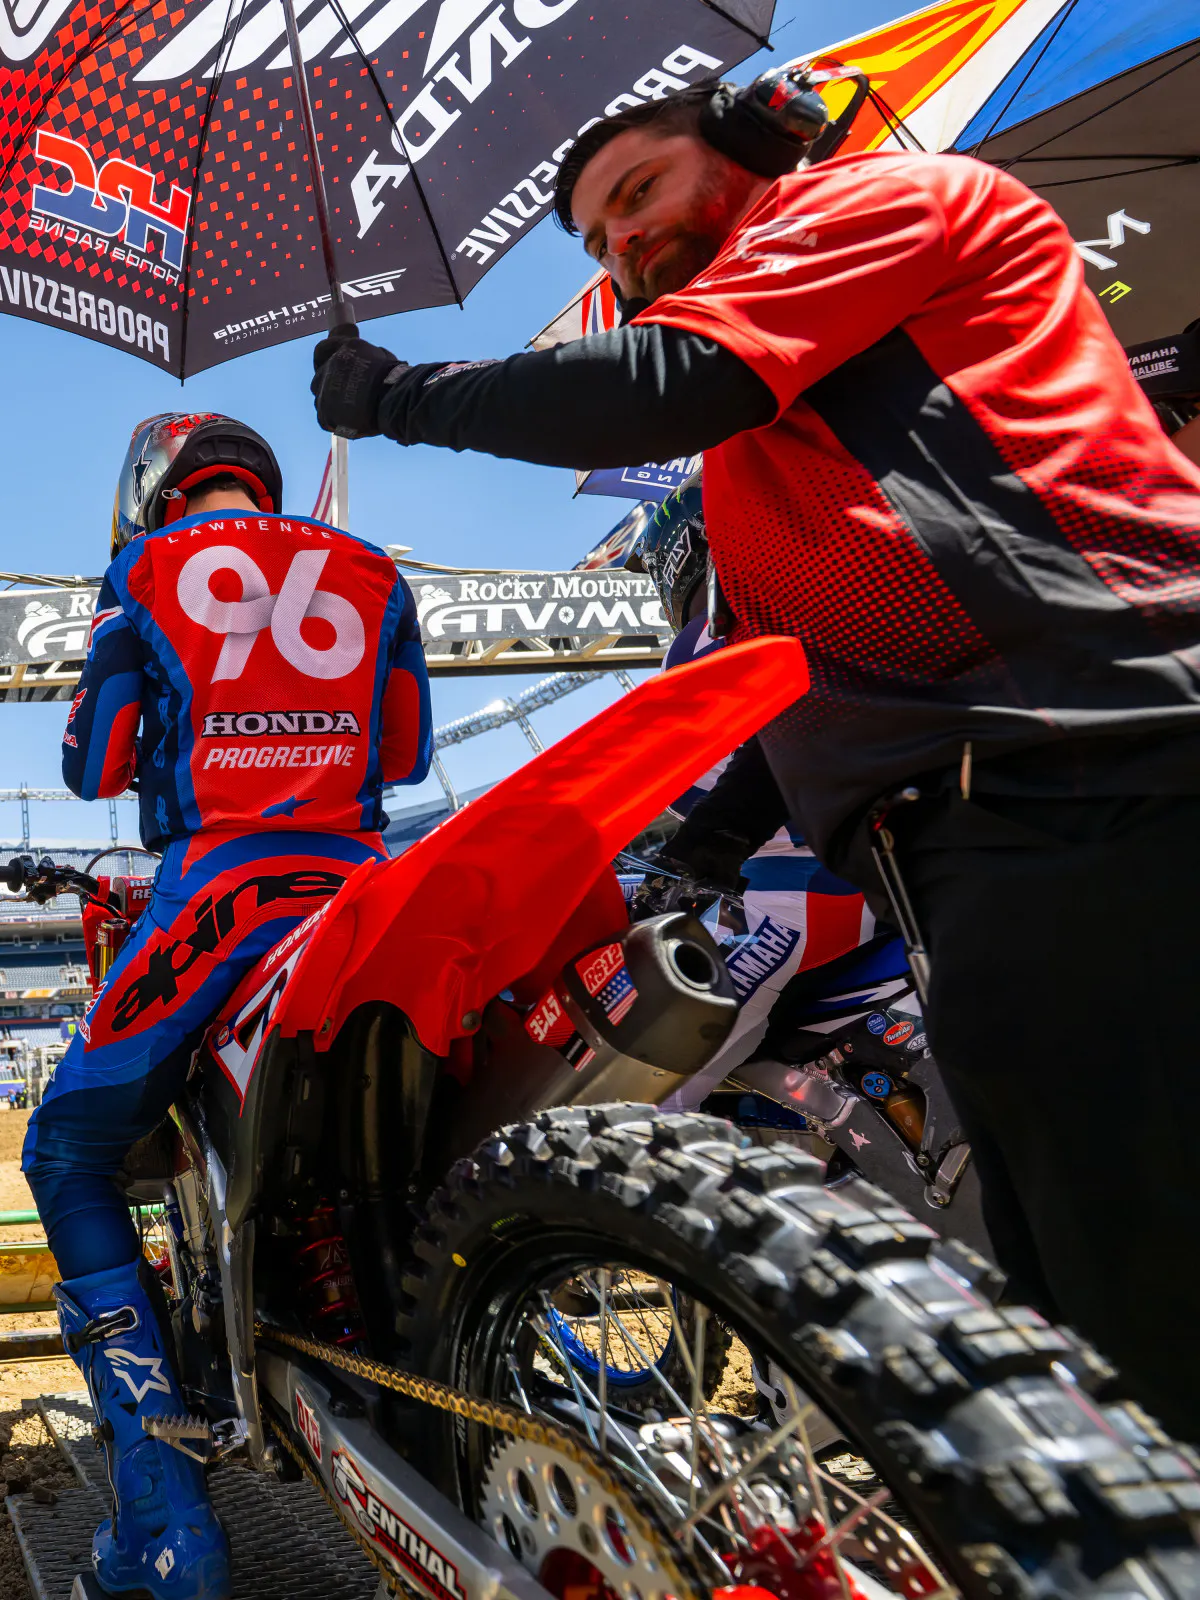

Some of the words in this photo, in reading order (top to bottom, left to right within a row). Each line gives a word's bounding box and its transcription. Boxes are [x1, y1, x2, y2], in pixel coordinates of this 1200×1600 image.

[167, 519, 333, 544] LAWRENCE
[663, 526, 692, 588] FLY
[458, 579, 546, 602] ROCKY
[176, 545, 366, 685] 96
[202, 712, 361, 737] HONDA
[202, 744, 356, 770] PROGRESSIVE
